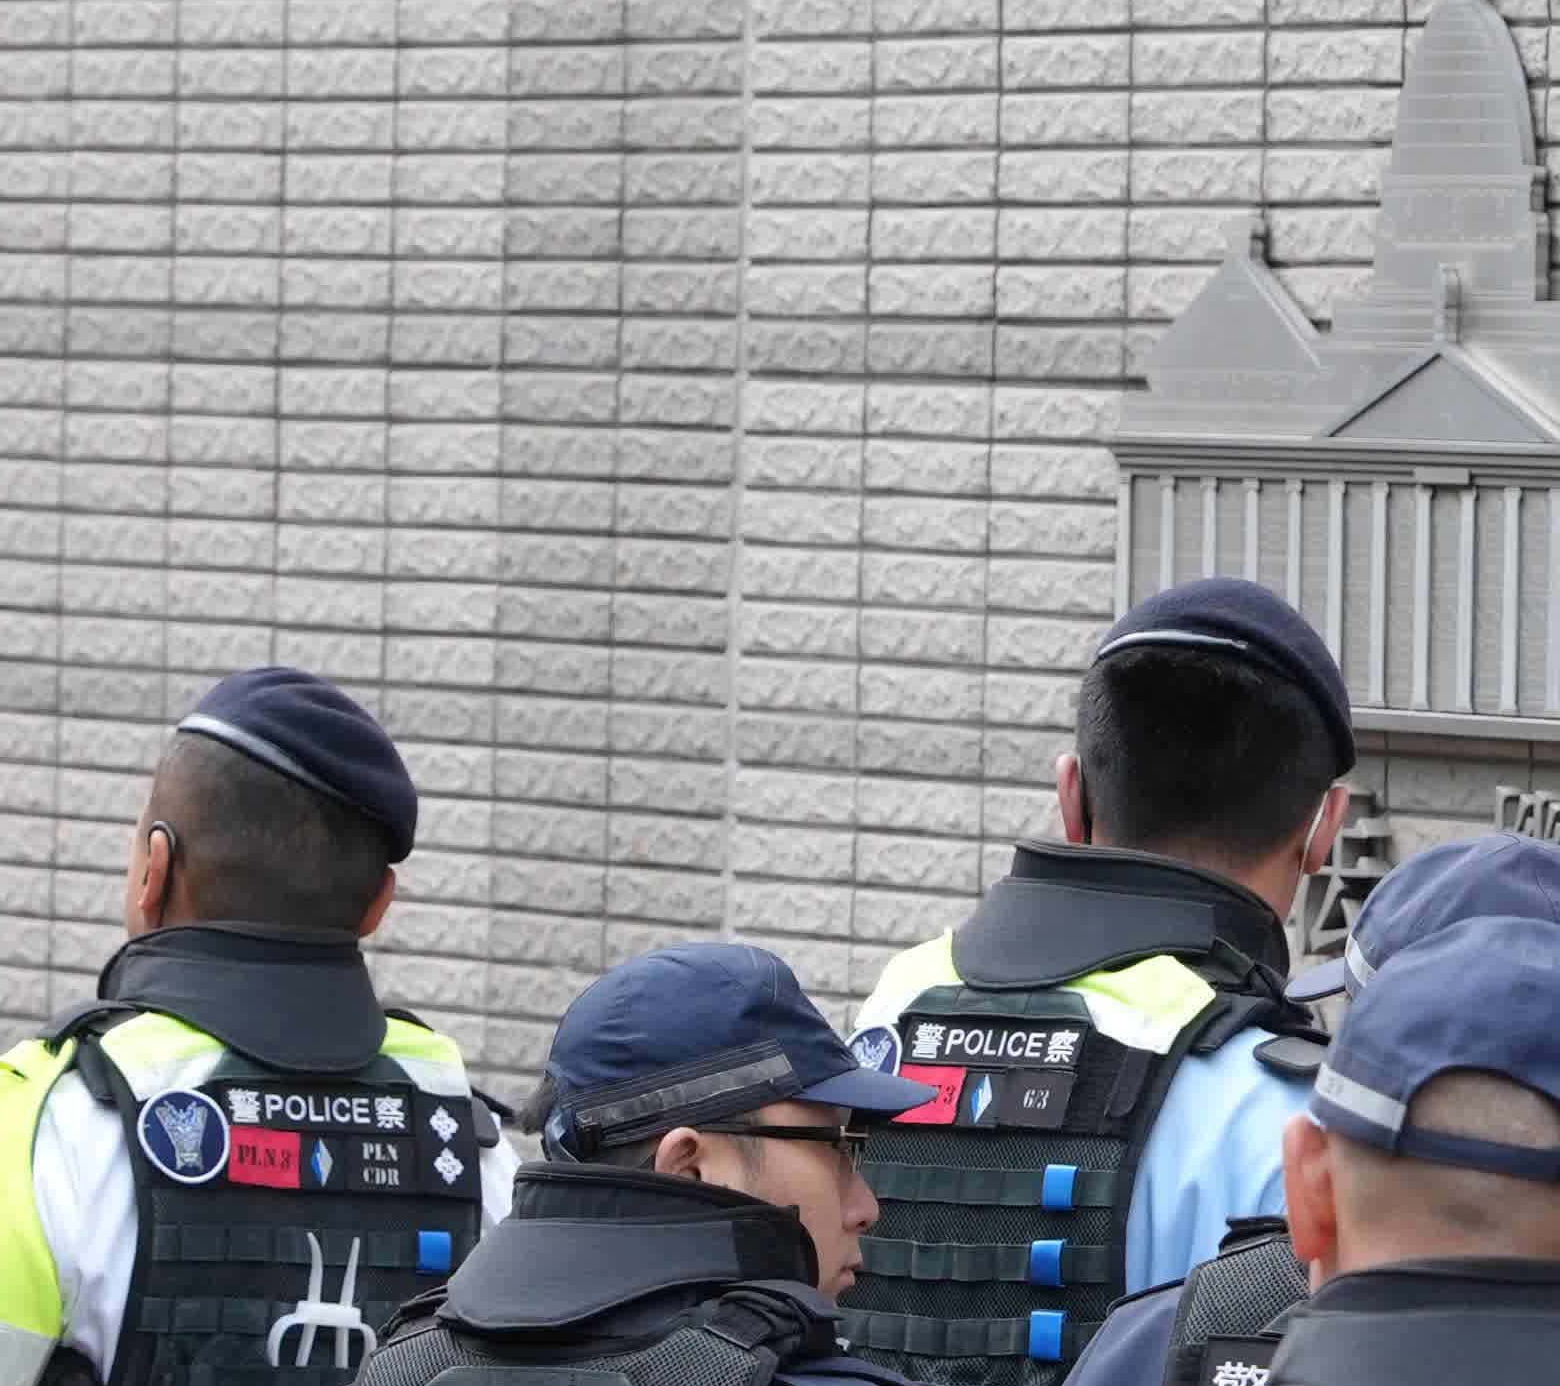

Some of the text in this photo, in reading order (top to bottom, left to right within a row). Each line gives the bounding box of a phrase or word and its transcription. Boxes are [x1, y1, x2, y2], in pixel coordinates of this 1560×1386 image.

[911, 1022, 1080, 1063] 警 POLICE 察
[228, 1088, 406, 1129] 警 POLICE 察
[238, 1143, 292, 1170] PLN 3
[362, 1142, 398, 1161] PLN
[362, 1167, 400, 1186] CDR
